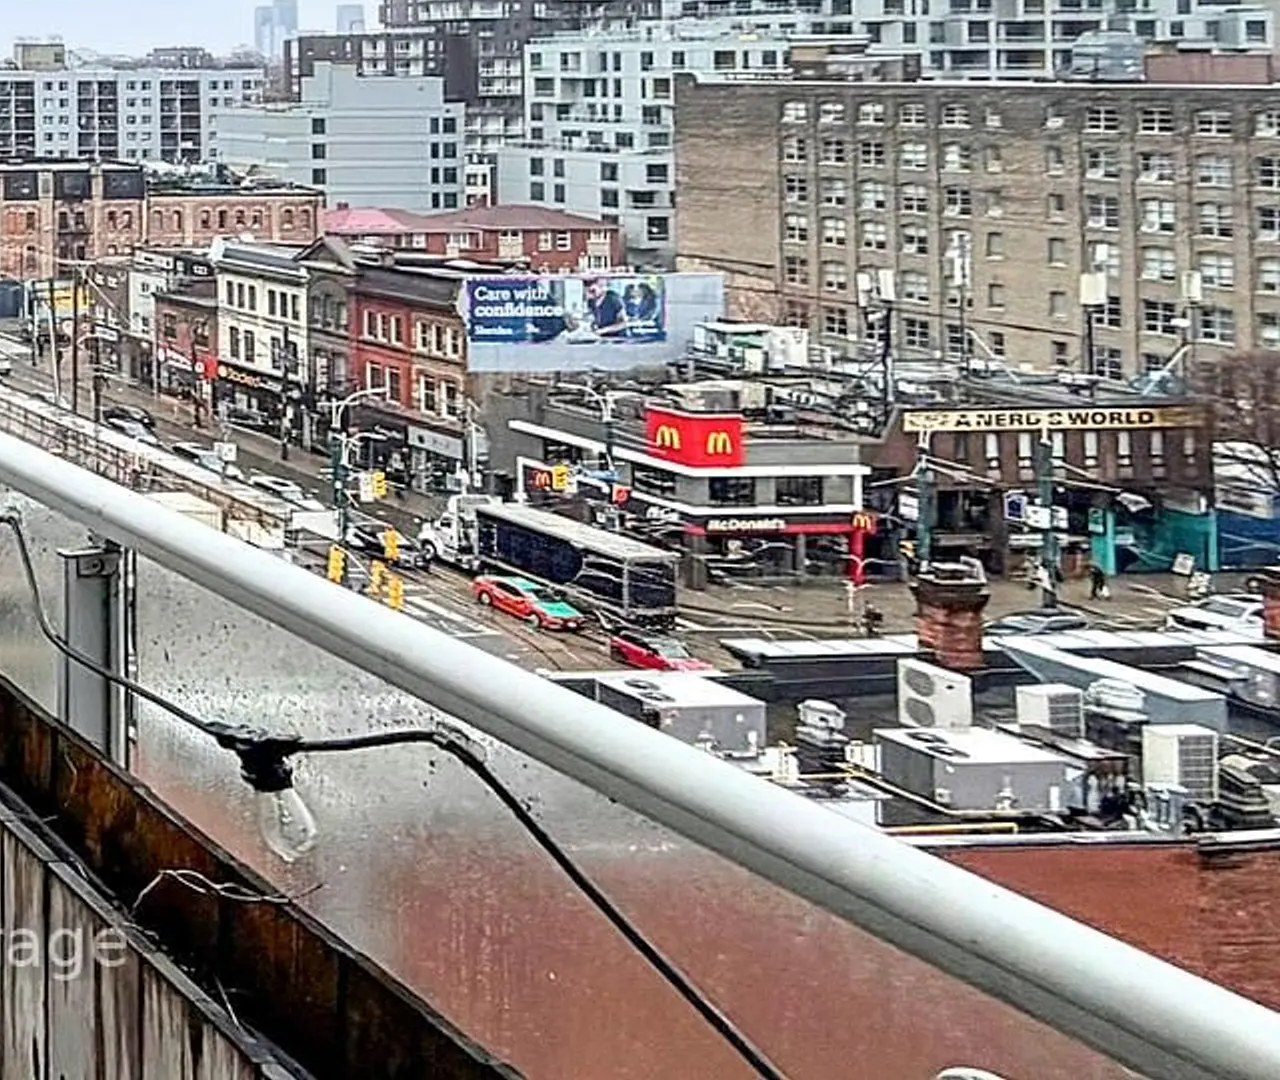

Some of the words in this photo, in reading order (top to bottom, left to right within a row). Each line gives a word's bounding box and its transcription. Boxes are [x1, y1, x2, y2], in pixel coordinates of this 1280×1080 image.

[474, 286, 511, 302] Care
[514, 285, 548, 302] with
[474, 302, 564, 318] confidence
[954, 413, 971, 428] A
[975, 412, 1064, 427] NERDS
[1067, 410, 1154, 426] WORLD
